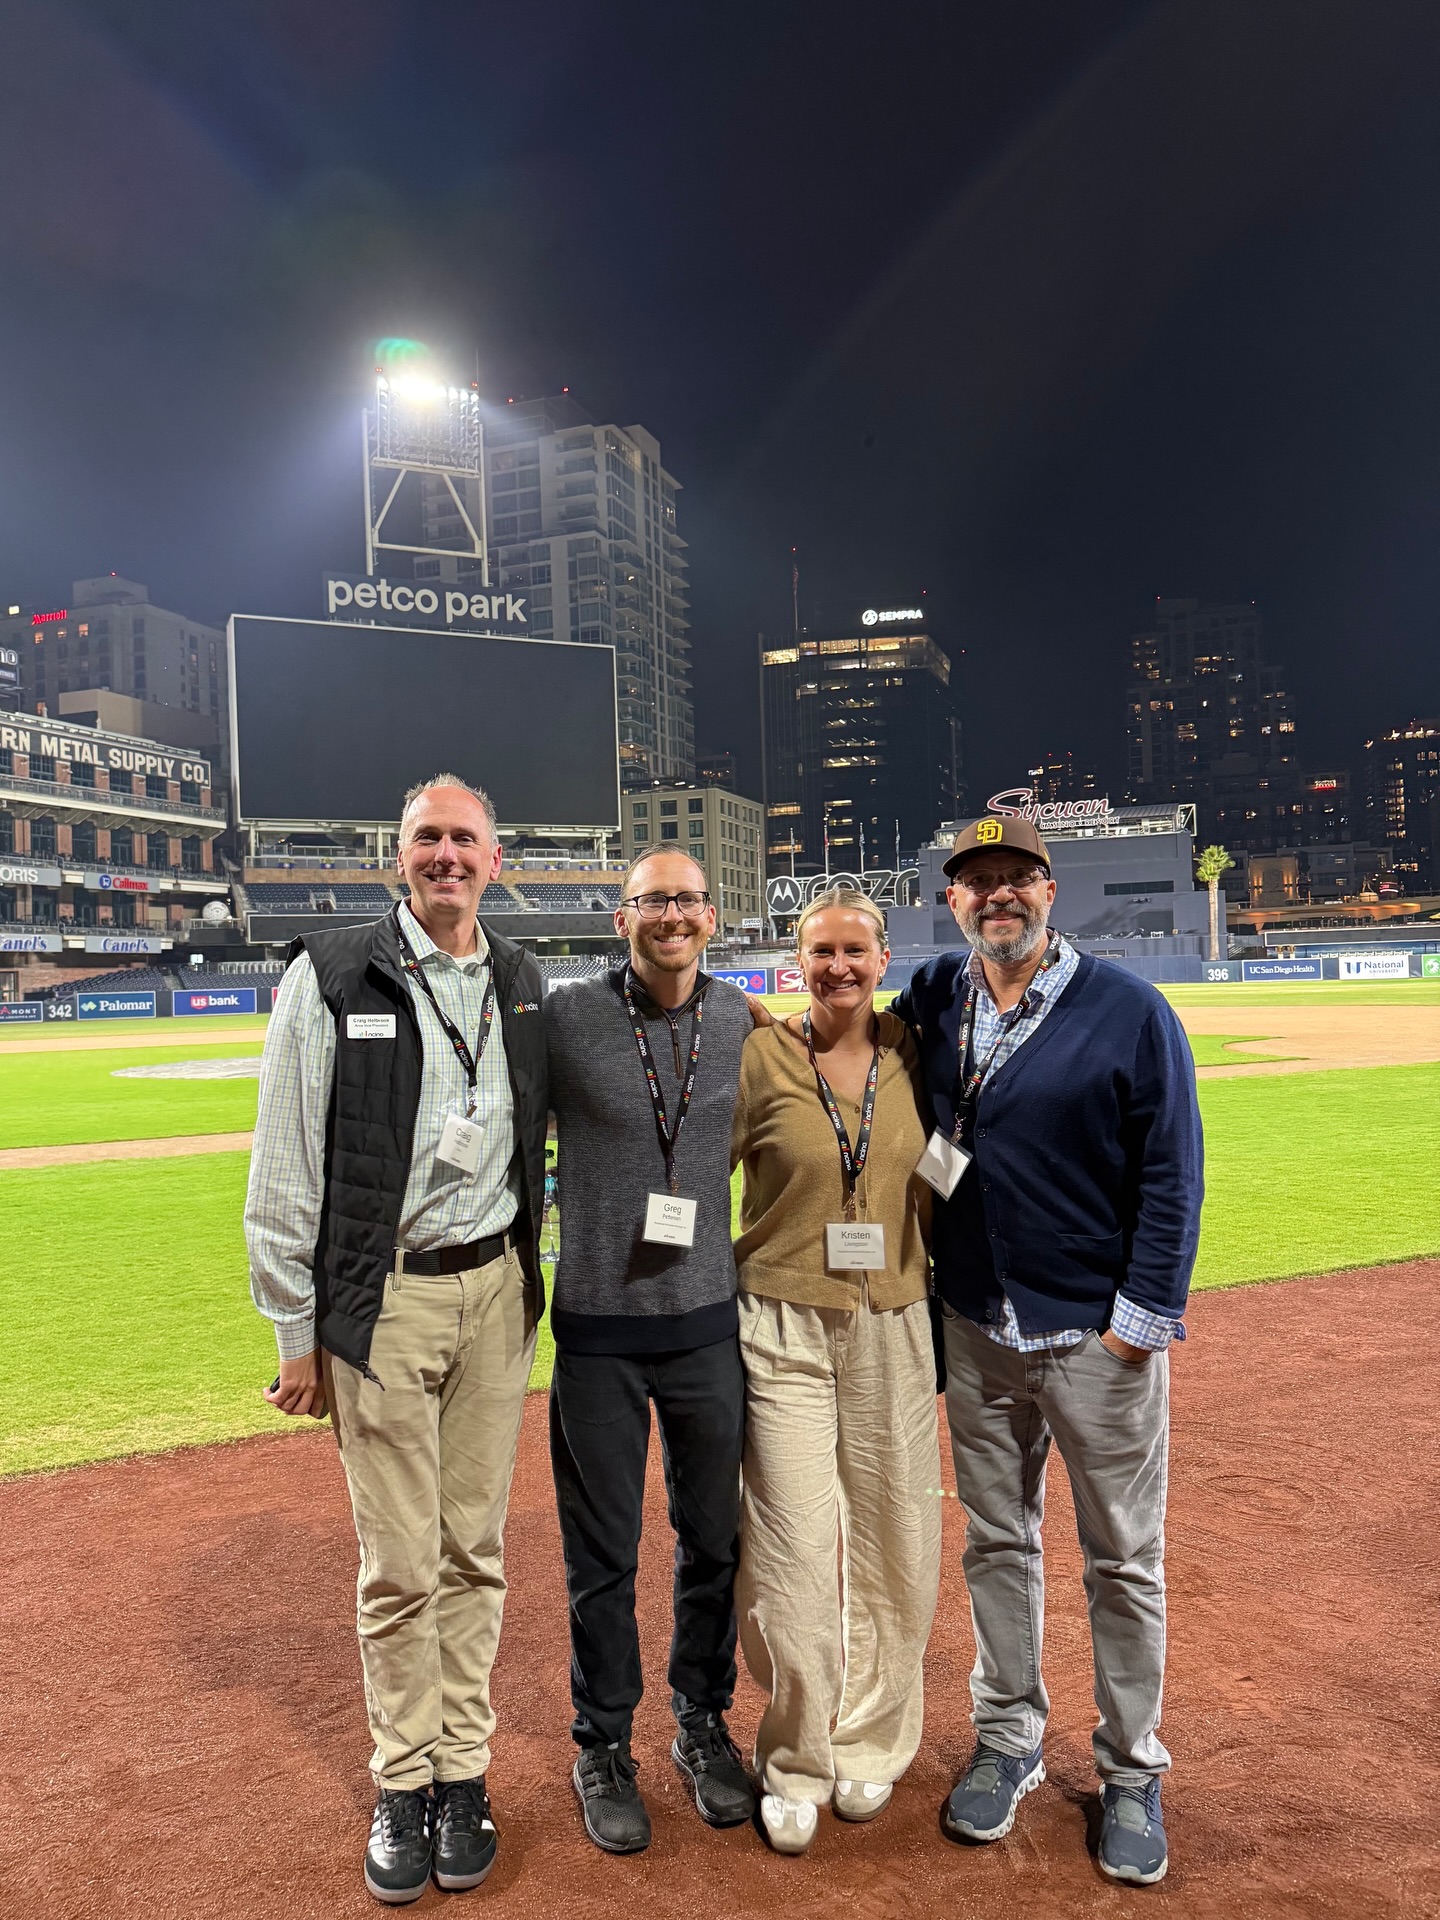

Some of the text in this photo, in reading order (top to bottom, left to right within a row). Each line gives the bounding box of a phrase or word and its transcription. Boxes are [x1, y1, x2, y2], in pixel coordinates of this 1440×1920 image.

[328, 578, 528, 623] petco park
[32, 610, 67, 626] Marriott
[879, 609, 923, 621] SEMPRA
[0, 727, 209, 784] RN METAL SUPPLY CO.
[987, 788, 1114, 825] Sycuan
[112, 876, 149, 891] Calimax
[0, 936, 47, 951] anel's
[103, 938, 149, 952] Canel's
[1249, 965, 1315, 975] UC San Diego Health
[1365, 960, 1404, 969] National
[1208, 968, 1229, 981] 396
[99, 1000, 153, 1011] Palomar
[192, 995, 239, 1007] us bank
[48, 1004, 72, 1018] 342
[638, 1038, 647, 1056] ncino
[649, 1079, 659, 1098] ncino
[687, 1074, 695, 1093] ncino
[831, 1111, 841, 1129] ncino
[860, 1142, 868, 1161] ncino
[843, 1152, 852, 1171] ncino
[663, 1203, 682, 1216] Greg
[841, 1231, 871, 1240] Kristen
